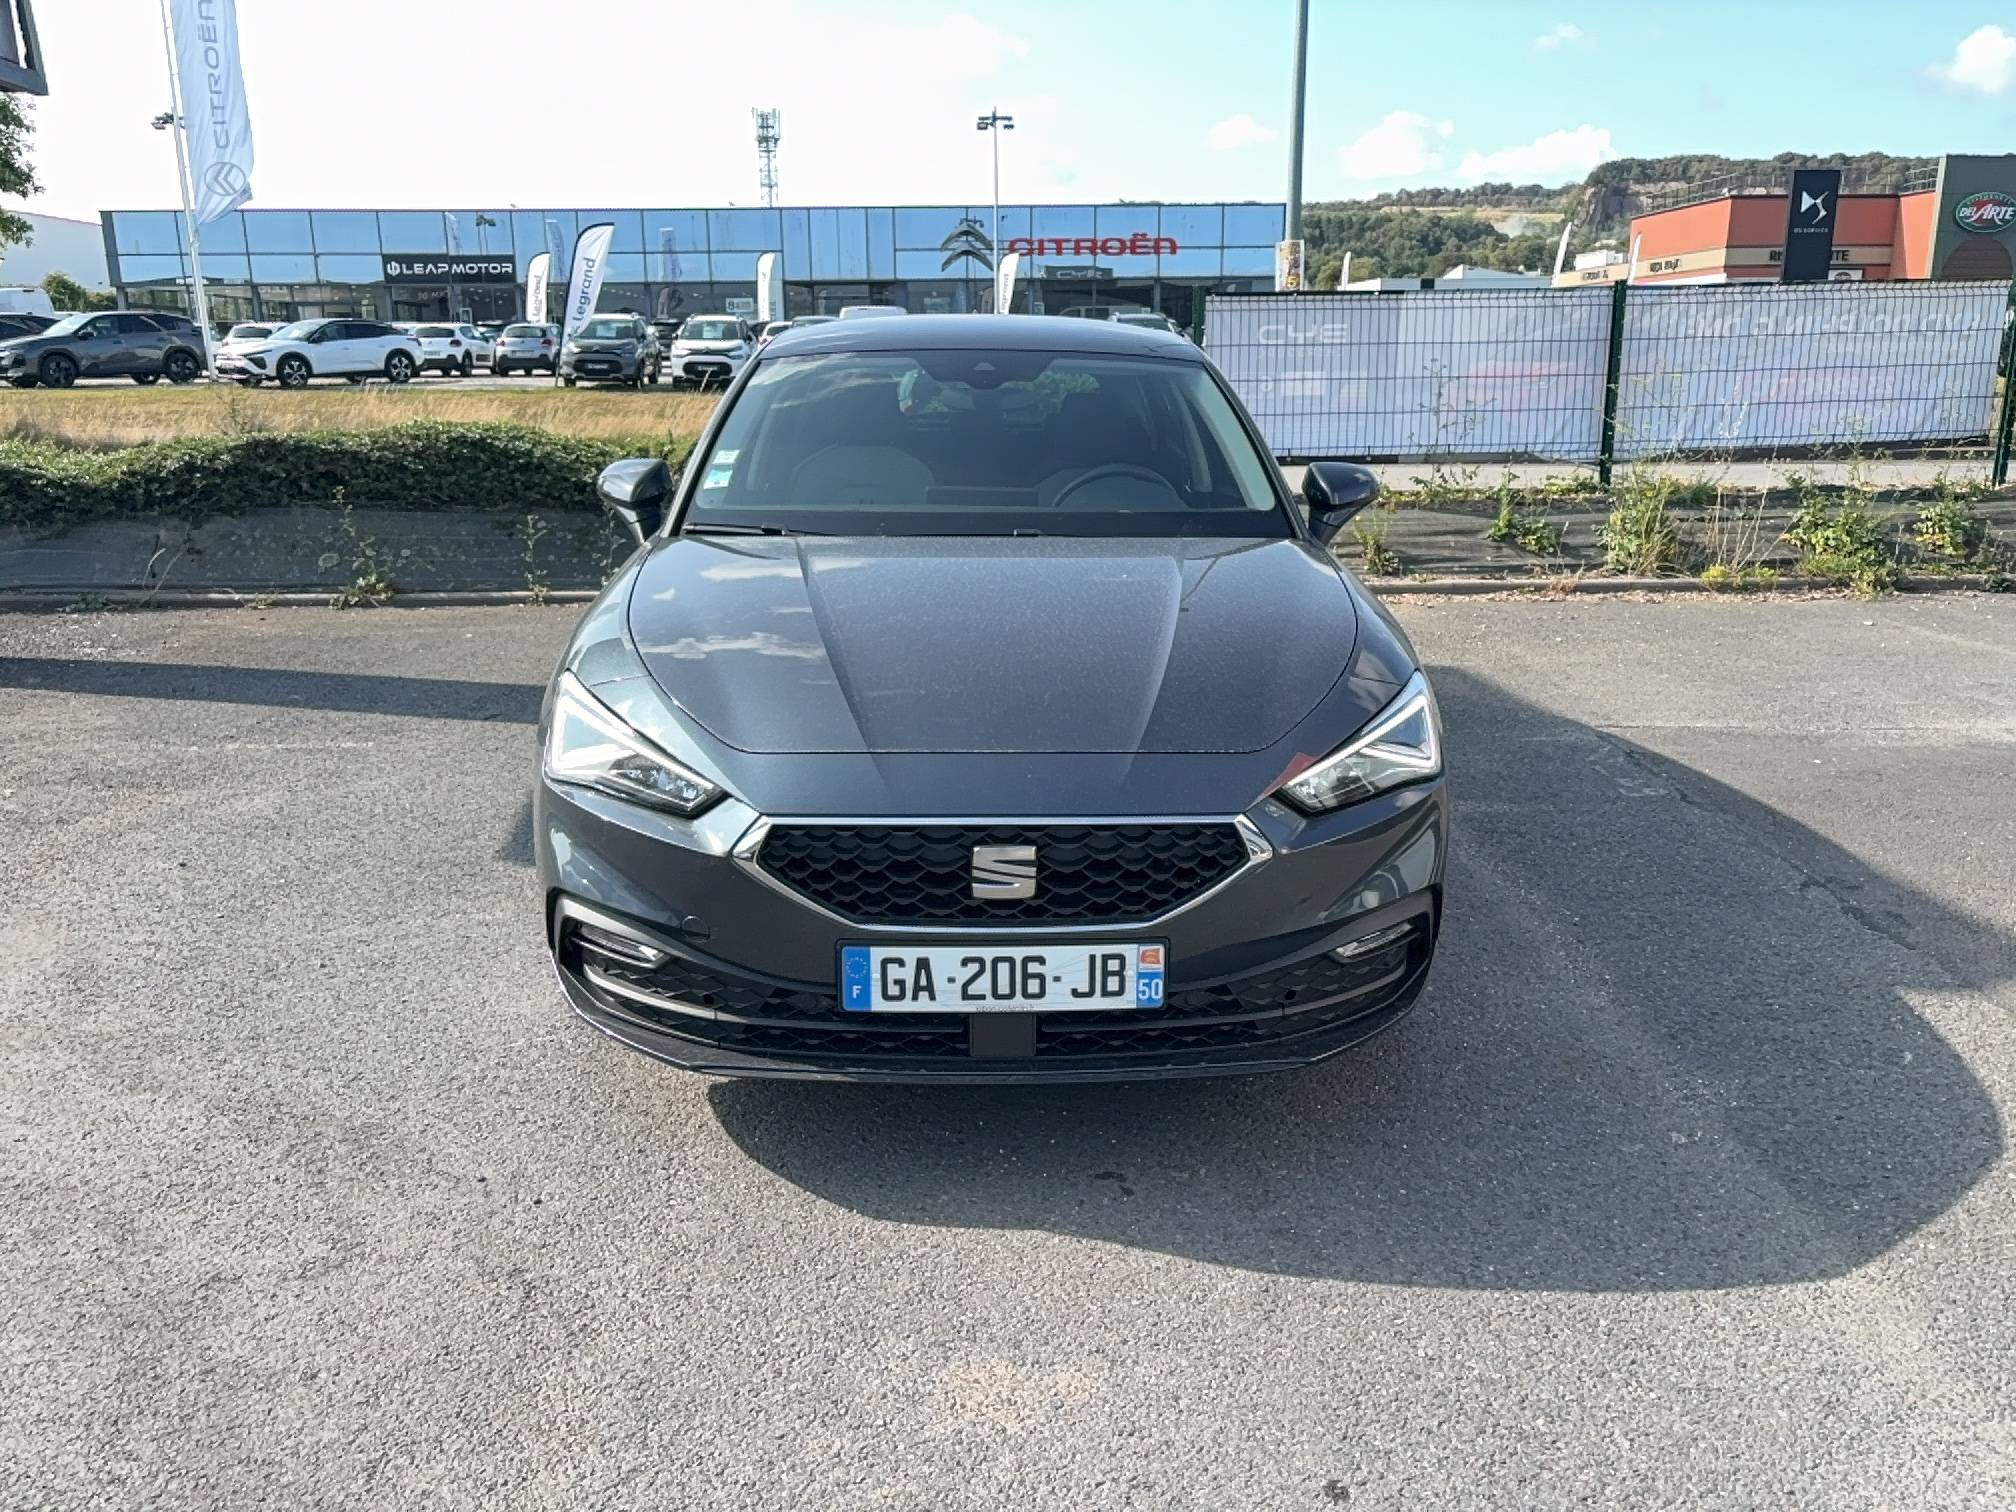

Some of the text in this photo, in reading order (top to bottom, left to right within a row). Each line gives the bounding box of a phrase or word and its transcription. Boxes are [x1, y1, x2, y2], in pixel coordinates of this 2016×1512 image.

[880, 953, 1127, 1002] GA-206-JB
[852, 985, 861, 999] F
[1138, 978, 1163, 1000] 50
